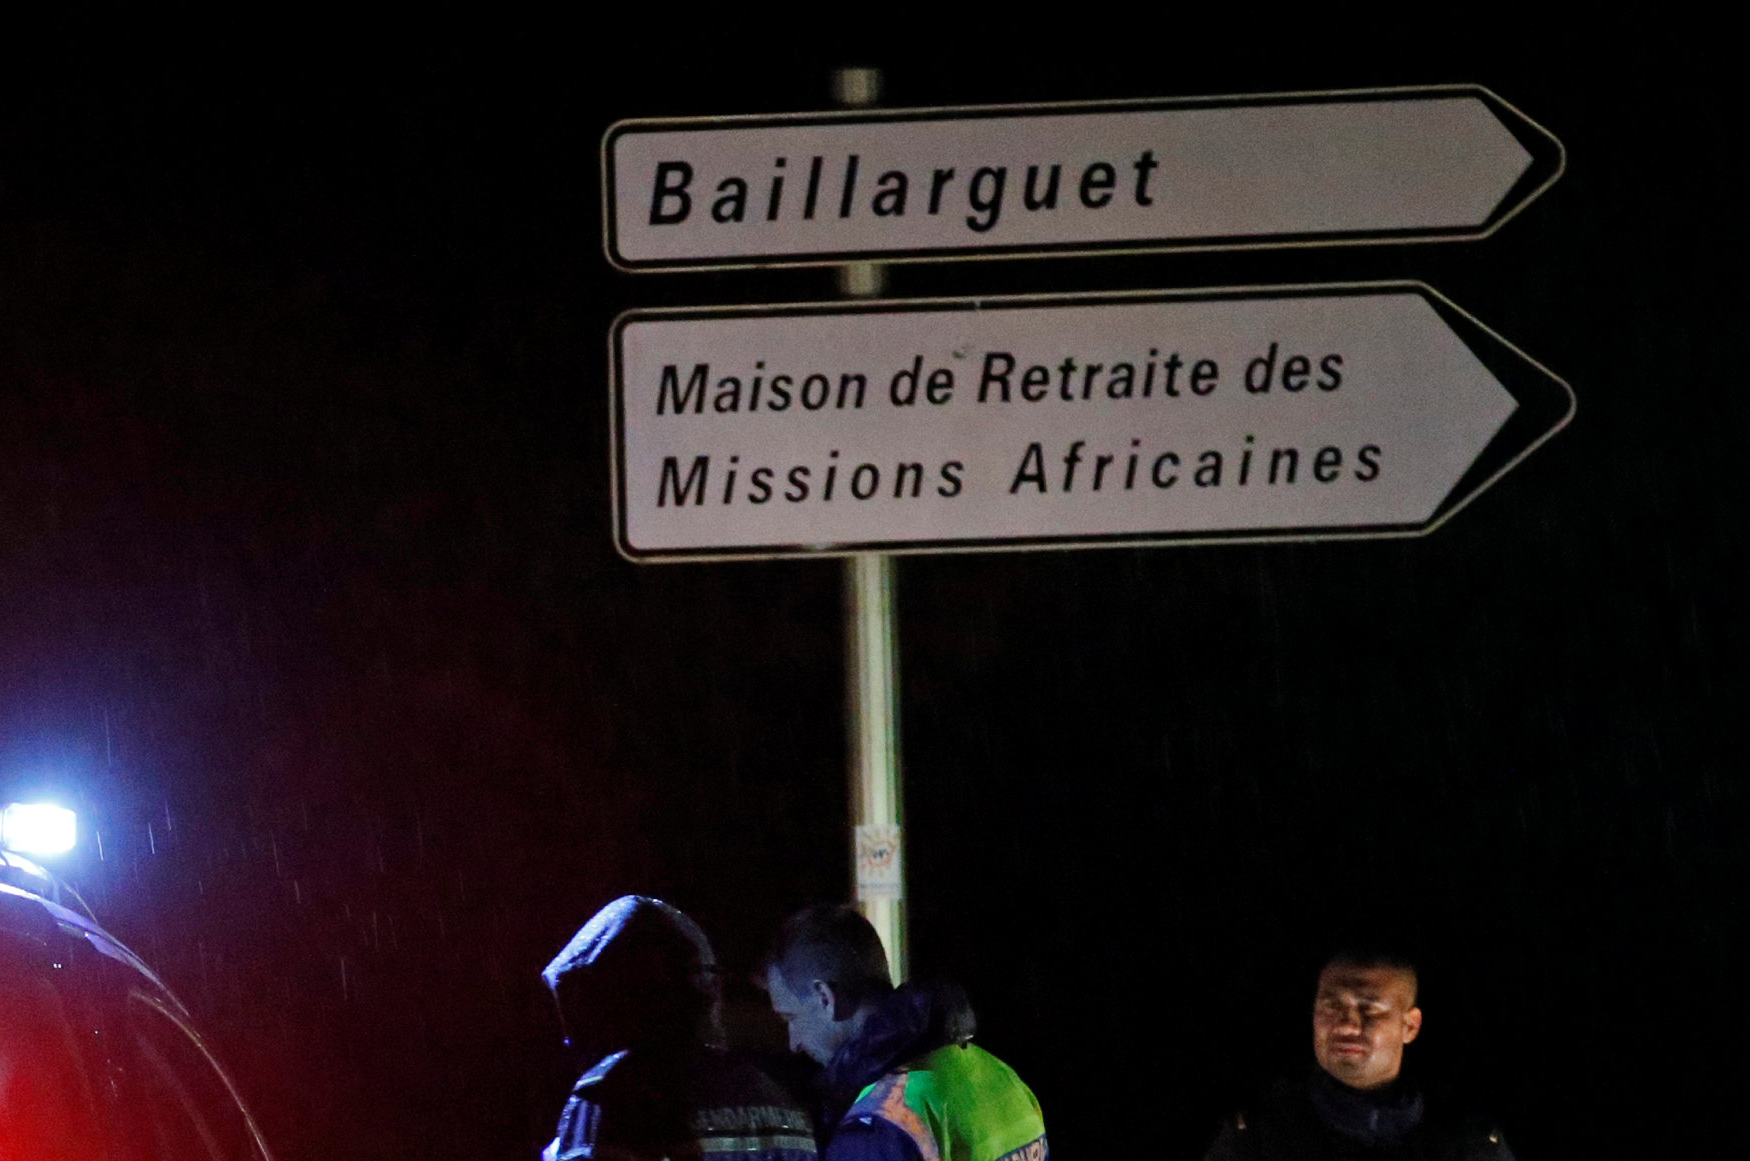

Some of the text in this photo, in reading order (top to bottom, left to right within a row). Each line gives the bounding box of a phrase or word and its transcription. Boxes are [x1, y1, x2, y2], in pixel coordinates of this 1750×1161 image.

[648, 148, 1161, 235] Baillarguet
[656, 340, 1344, 416] Maison de Retraite des
[657, 434, 1383, 508] Missions Africaines
